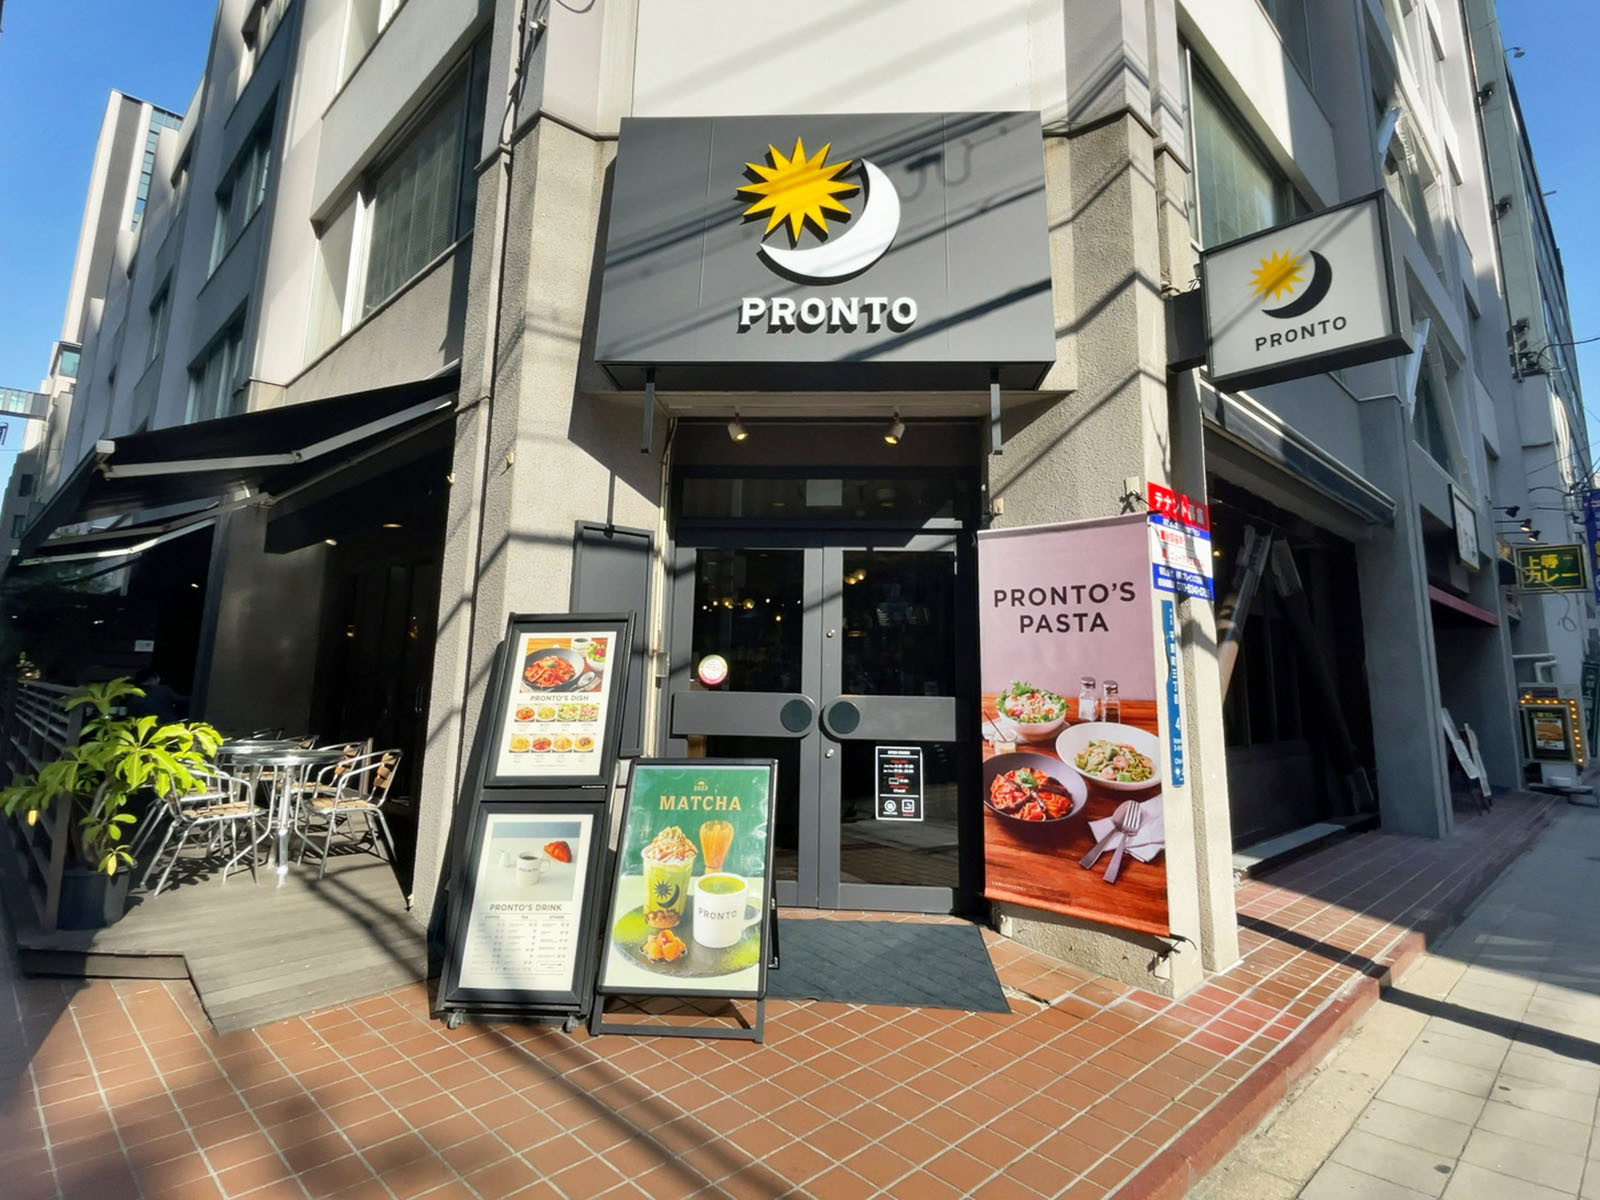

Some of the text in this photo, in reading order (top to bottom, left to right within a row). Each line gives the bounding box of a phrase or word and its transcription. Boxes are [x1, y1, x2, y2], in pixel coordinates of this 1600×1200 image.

[741, 296, 918, 327] PRONTO
[1255, 316, 1347, 352] PRONTO
[1525, 569, 1579, 585] カレー
[994, 581, 1136, 608] PRONTO’S
[1019, 612, 1110, 634] PASTA
[529, 694, 569, 702] PRONTO’S
[658, 795, 742, 812] MATCHA
[489, 903, 563, 912] PRONTO’S DRINK
[697, 906, 738, 921] PRONTO
